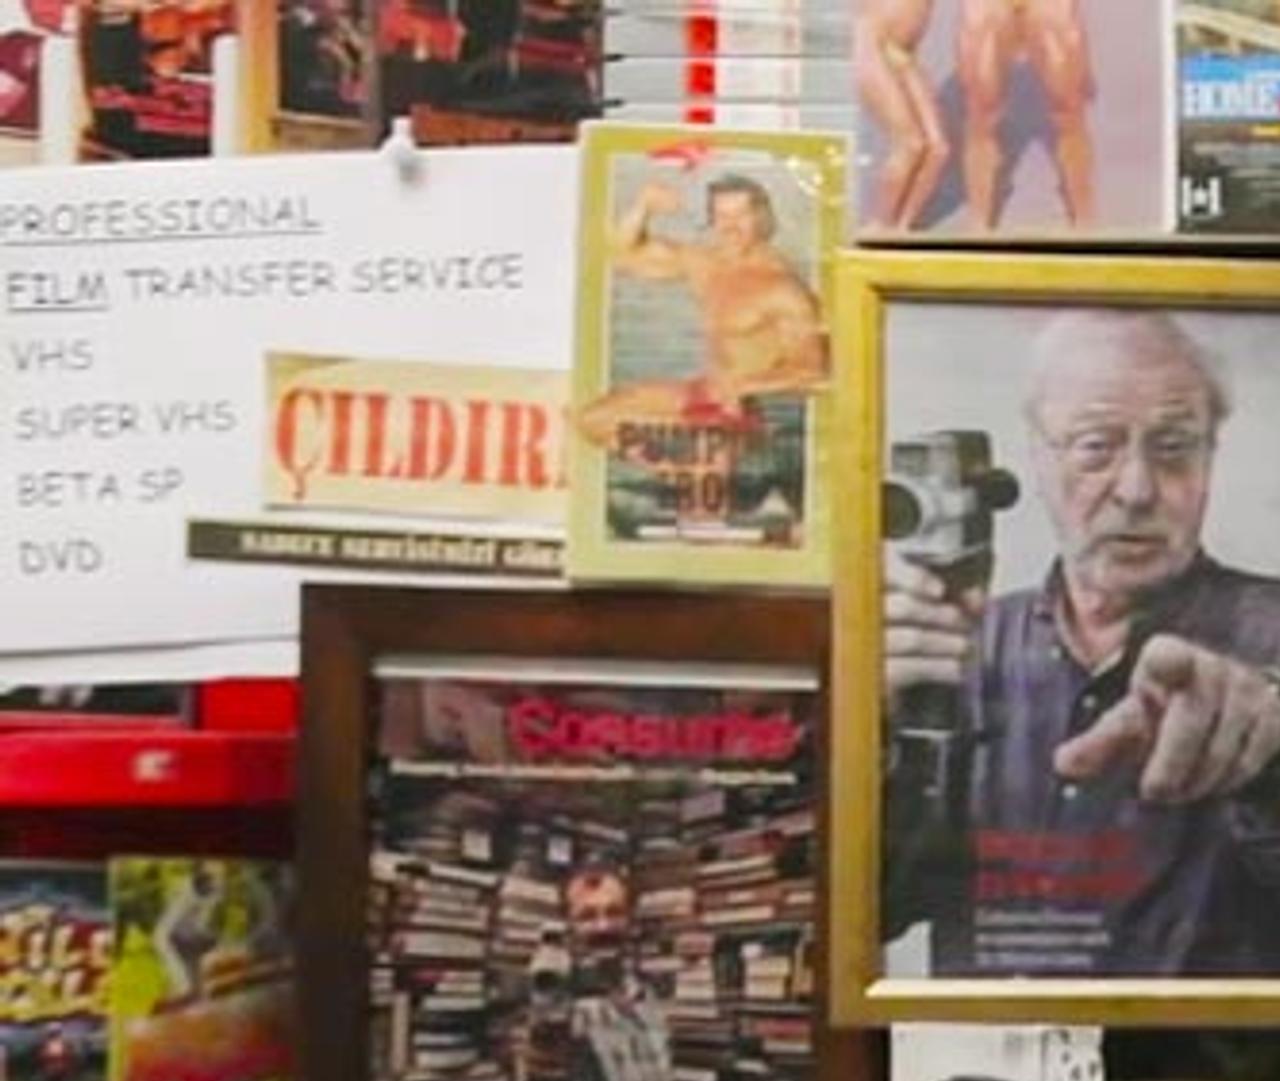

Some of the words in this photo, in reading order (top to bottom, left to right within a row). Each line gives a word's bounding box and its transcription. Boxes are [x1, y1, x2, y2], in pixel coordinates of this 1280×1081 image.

[1183, 80, 1269, 118] HOME
[0, 197, 322, 236] PROFESSIONAL
[5, 270, 109, 306] FILM
[124, 259, 337, 299] TRANSFER
[351, 252, 524, 293] SERVICE
[9, 338, 95, 373] VHS
[16, 401, 139, 441] SUPER
[158, 398, 238, 433] VHS
[274, 387, 569, 500] ÇILDIR
[17, 472, 120, 507] BETA
[138, 467, 184, 501] SP
[19, 540, 101, 575] DVD
